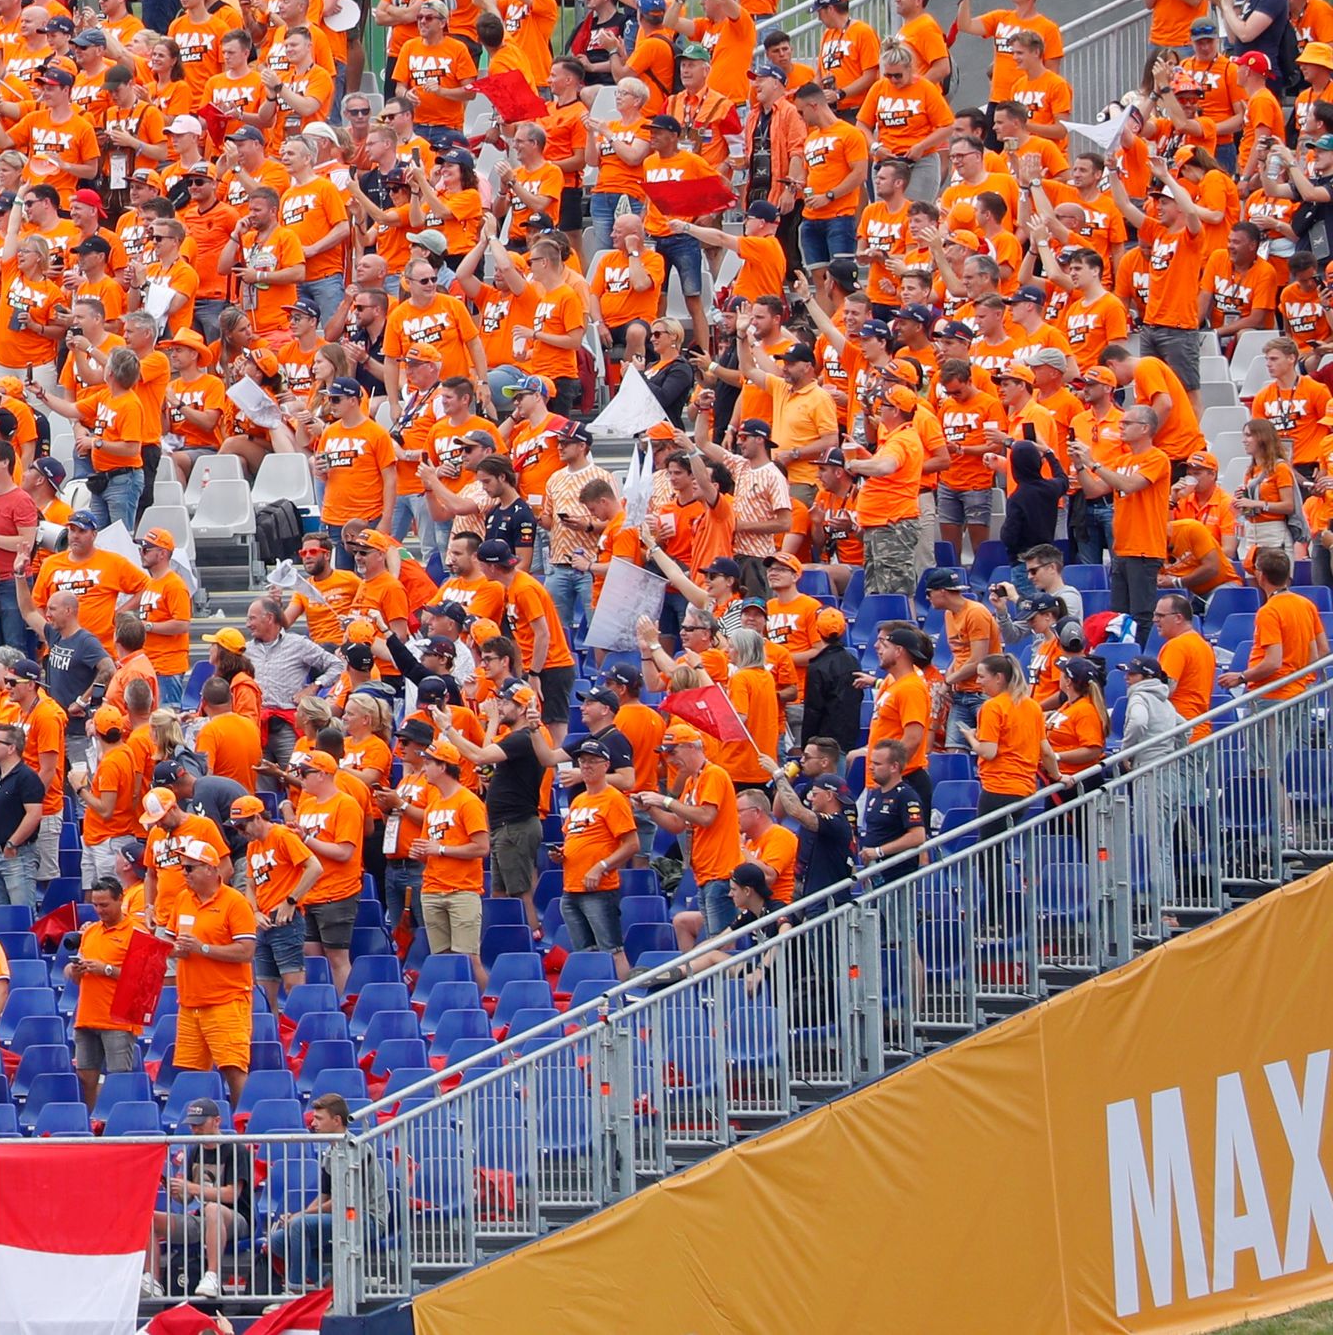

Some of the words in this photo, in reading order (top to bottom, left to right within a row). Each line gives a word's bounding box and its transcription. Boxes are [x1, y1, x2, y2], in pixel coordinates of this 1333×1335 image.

[996, 23, 1019, 38] MA
[175, 32, 215, 50] MAX
[270, 43, 286, 56] MA
[409, 55, 452, 73] MAX
[212, 87, 255, 102] MAX
[877, 96, 921, 114] MAX
[32, 128, 73, 150] MAX
[804, 136, 837, 152] MAX
[646, 168, 684, 182] MAX
[283, 194, 317, 212] MAX
[868, 222, 902, 239] MAX
[605, 267, 630, 282] MA
[1285, 302, 1323, 318] MAX
[402, 312, 450, 336] MAX
[941, 413, 980, 430] MAX
[325, 438, 367, 455] MAX
[435, 439, 462, 454] MA
[53, 569, 101, 585] MAX
[1106, 1049, 1333, 1318] MAX
